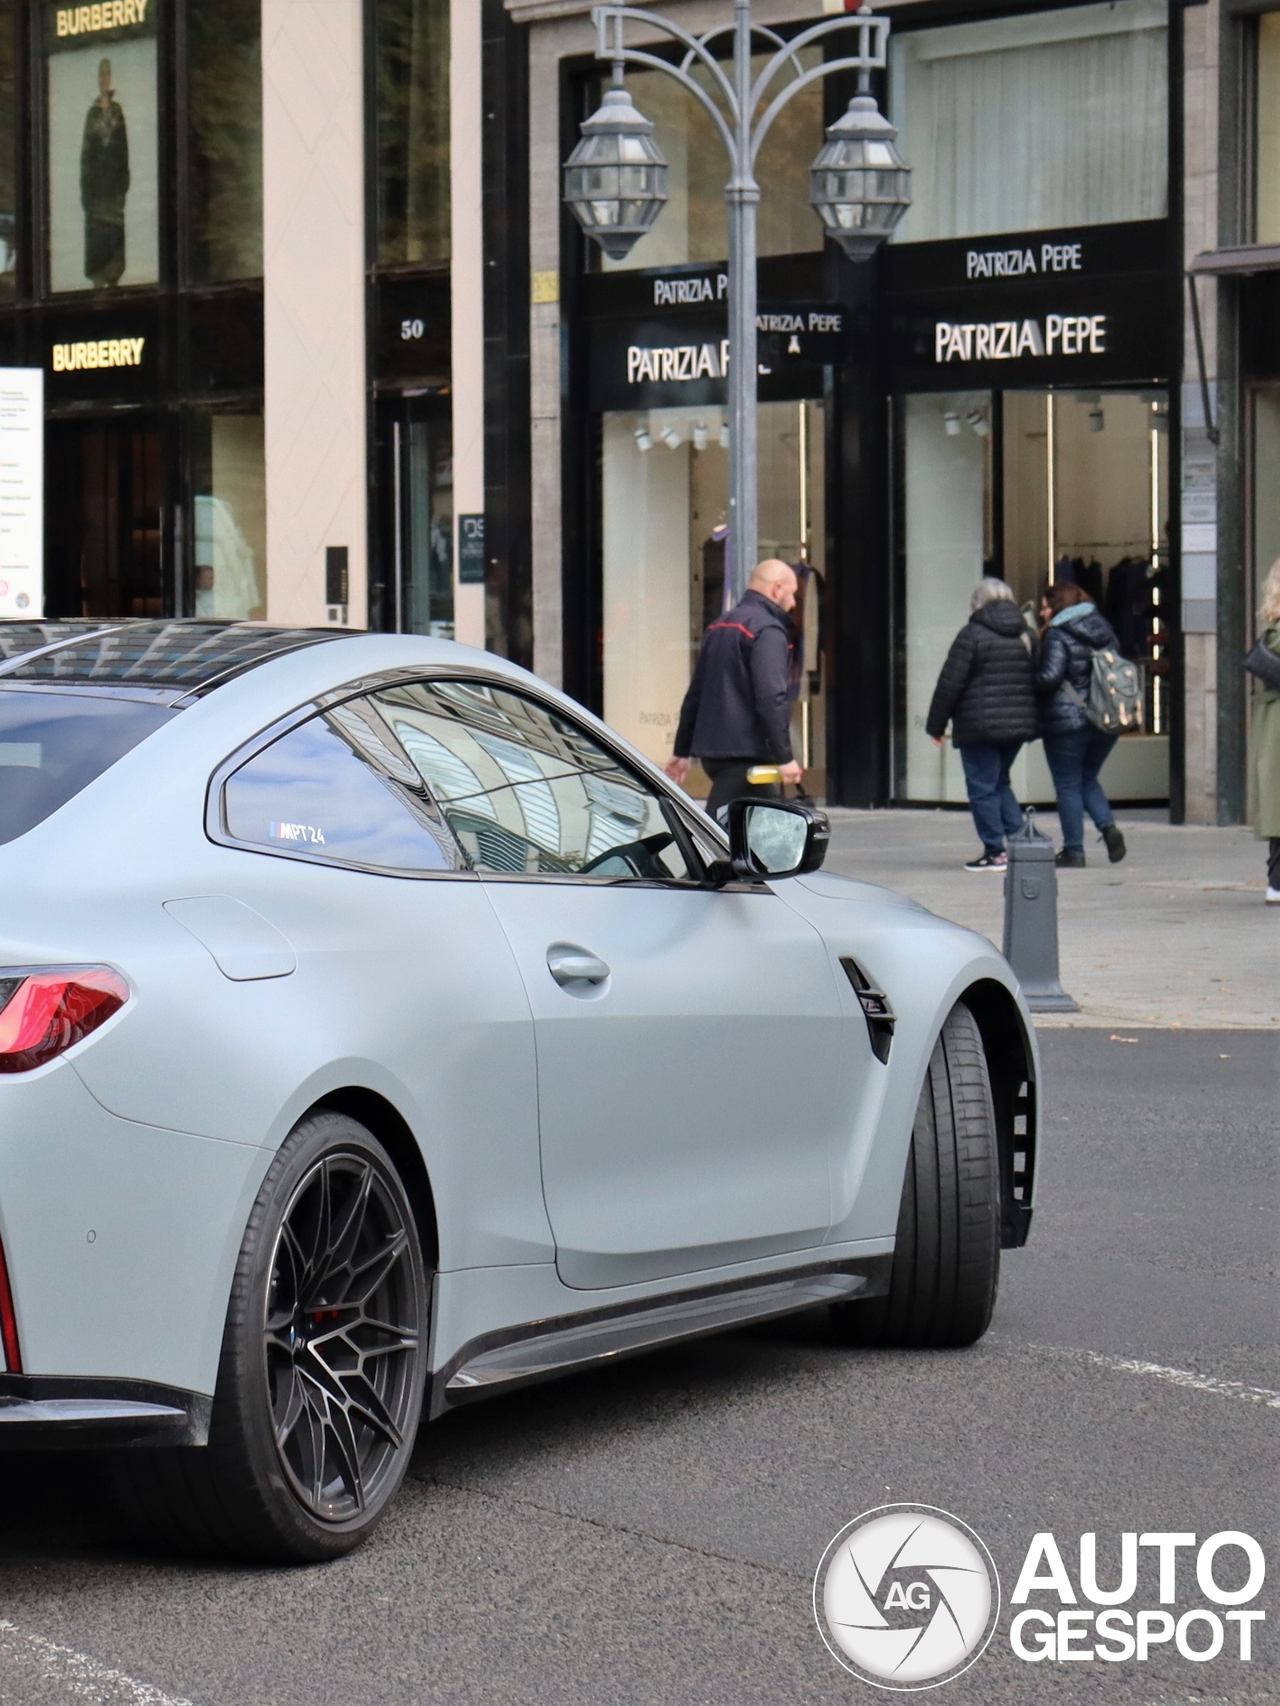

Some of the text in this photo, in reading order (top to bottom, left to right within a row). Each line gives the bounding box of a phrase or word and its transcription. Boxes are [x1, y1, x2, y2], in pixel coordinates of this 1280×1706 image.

[56, 0, 148, 37] BURBERRY
[966, 244, 1082, 279] PATRIZIA PEPE
[654, 278, 714, 305] PATRIZIA
[401, 319, 423, 340] 50
[756, 313, 842, 332] ATRIZIA PEPE
[935, 314, 1106, 363] PATRIZIA PEPE
[53, 337, 144, 372] BURBERRY
[628, 343, 718, 384] PATRIZIA
[308, 826, 326, 845] 24
